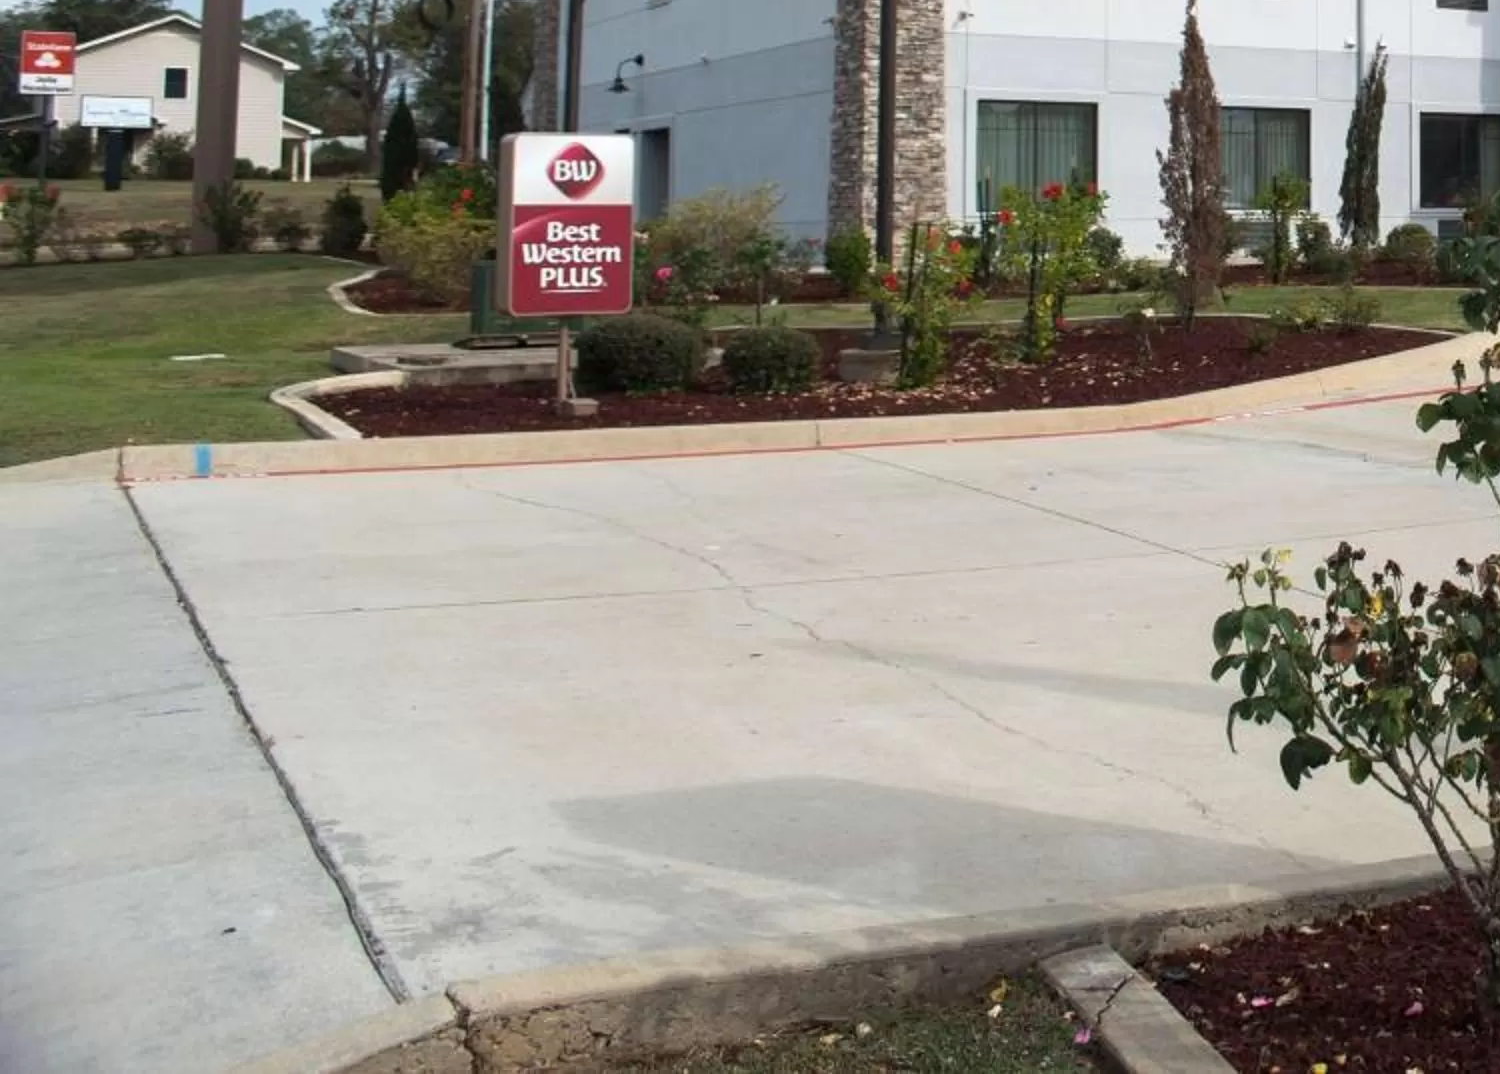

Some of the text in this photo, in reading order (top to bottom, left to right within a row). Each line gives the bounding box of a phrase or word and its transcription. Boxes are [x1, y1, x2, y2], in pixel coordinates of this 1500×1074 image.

[553, 159, 597, 182] BW
[546, 221, 601, 242] Best
[521, 243, 622, 264] Western
[540, 266, 604, 288] PLUS
